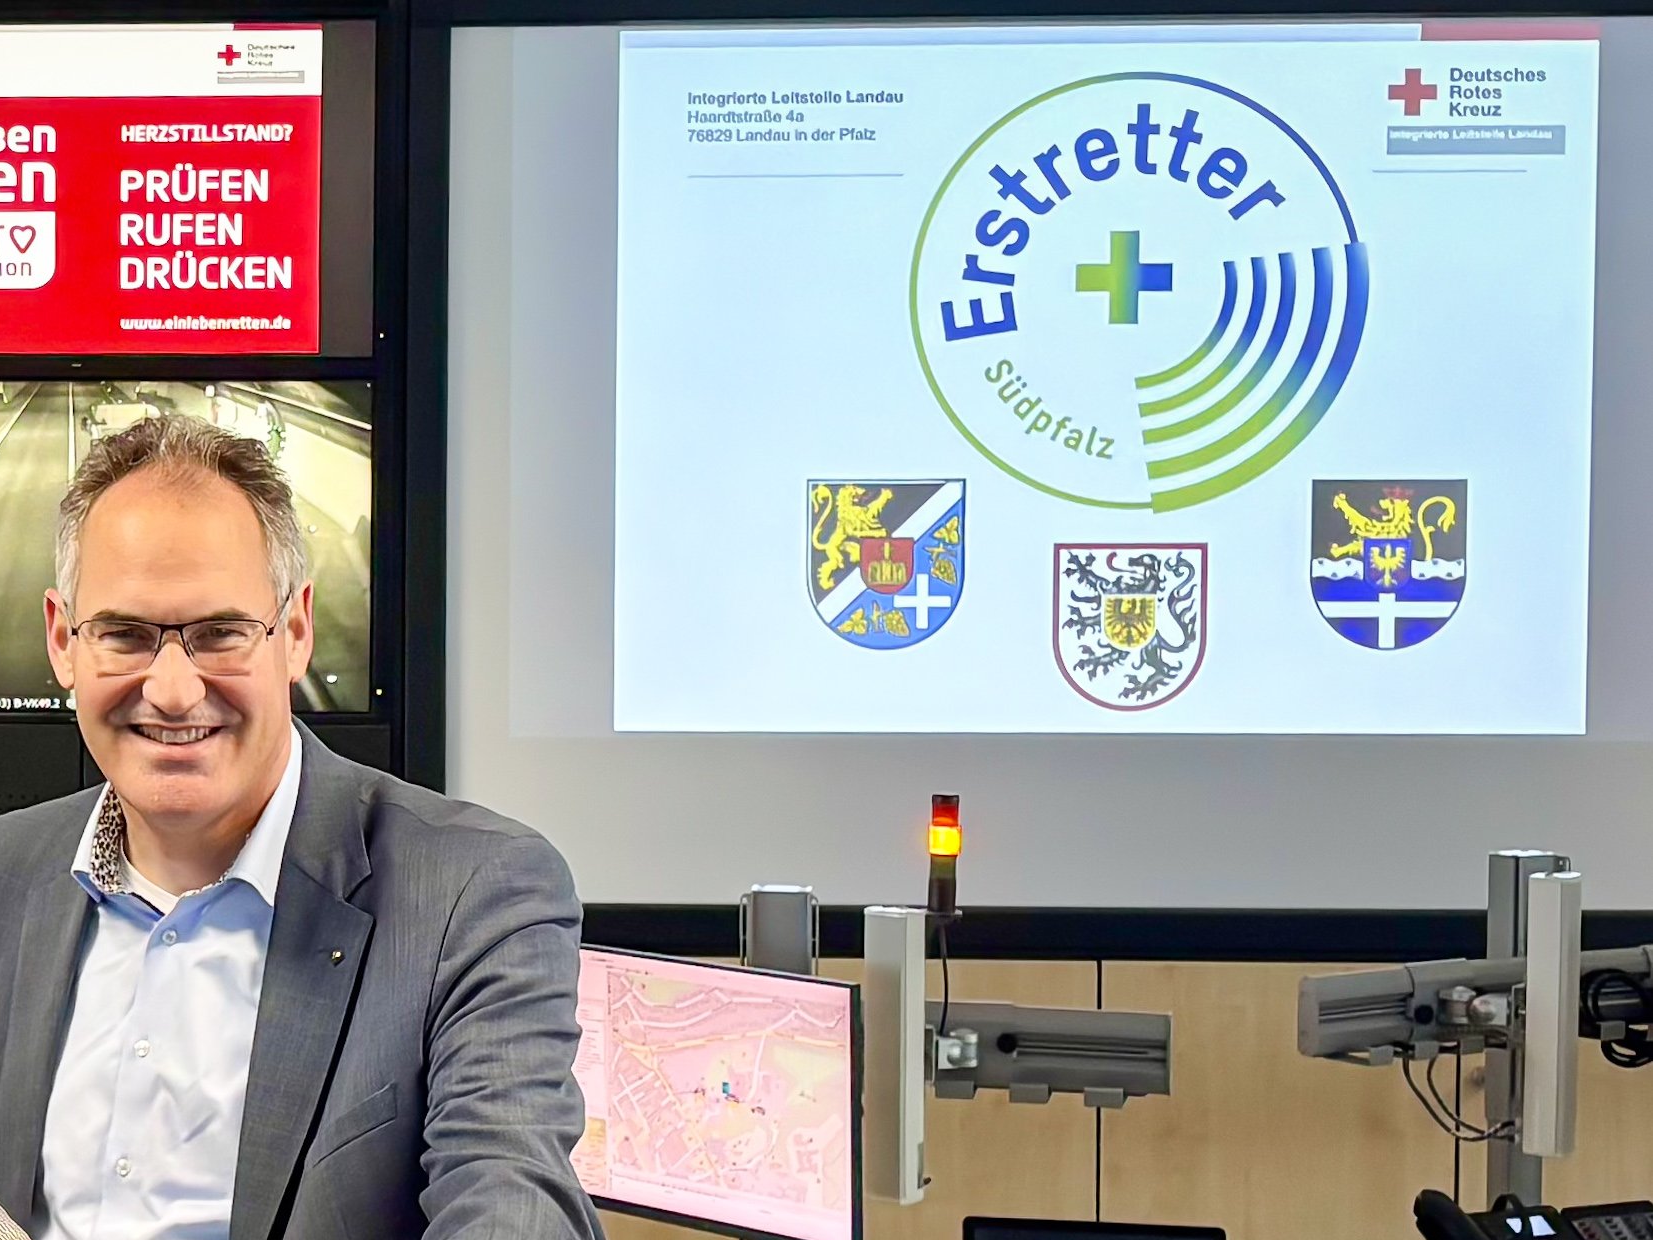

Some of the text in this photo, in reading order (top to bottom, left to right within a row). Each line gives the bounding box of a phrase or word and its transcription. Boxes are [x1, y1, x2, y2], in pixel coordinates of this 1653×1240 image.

[1449, 67, 1547, 82] Deutsches
[687, 90, 905, 108] Integrierte Leitstelle Landau
[1449, 85, 1503, 100] Rotes
[785, 110, 805, 124] 4a
[1449, 102, 1503, 117] Kreuz
[120, 123, 294, 143] HERZSTILLSTAND?
[687, 127, 877, 143] 76829 Landau in der Pfalz
[119, 162, 269, 203] PRÜFEN
[119, 212, 243, 246] RUFEN
[940, 103, 1286, 342] Erstretter
[119, 250, 293, 290] DRÜCKEN
[119, 314, 292, 331] www.einlebenretten.de
[984, 359, 1115, 460] Südpfalz
